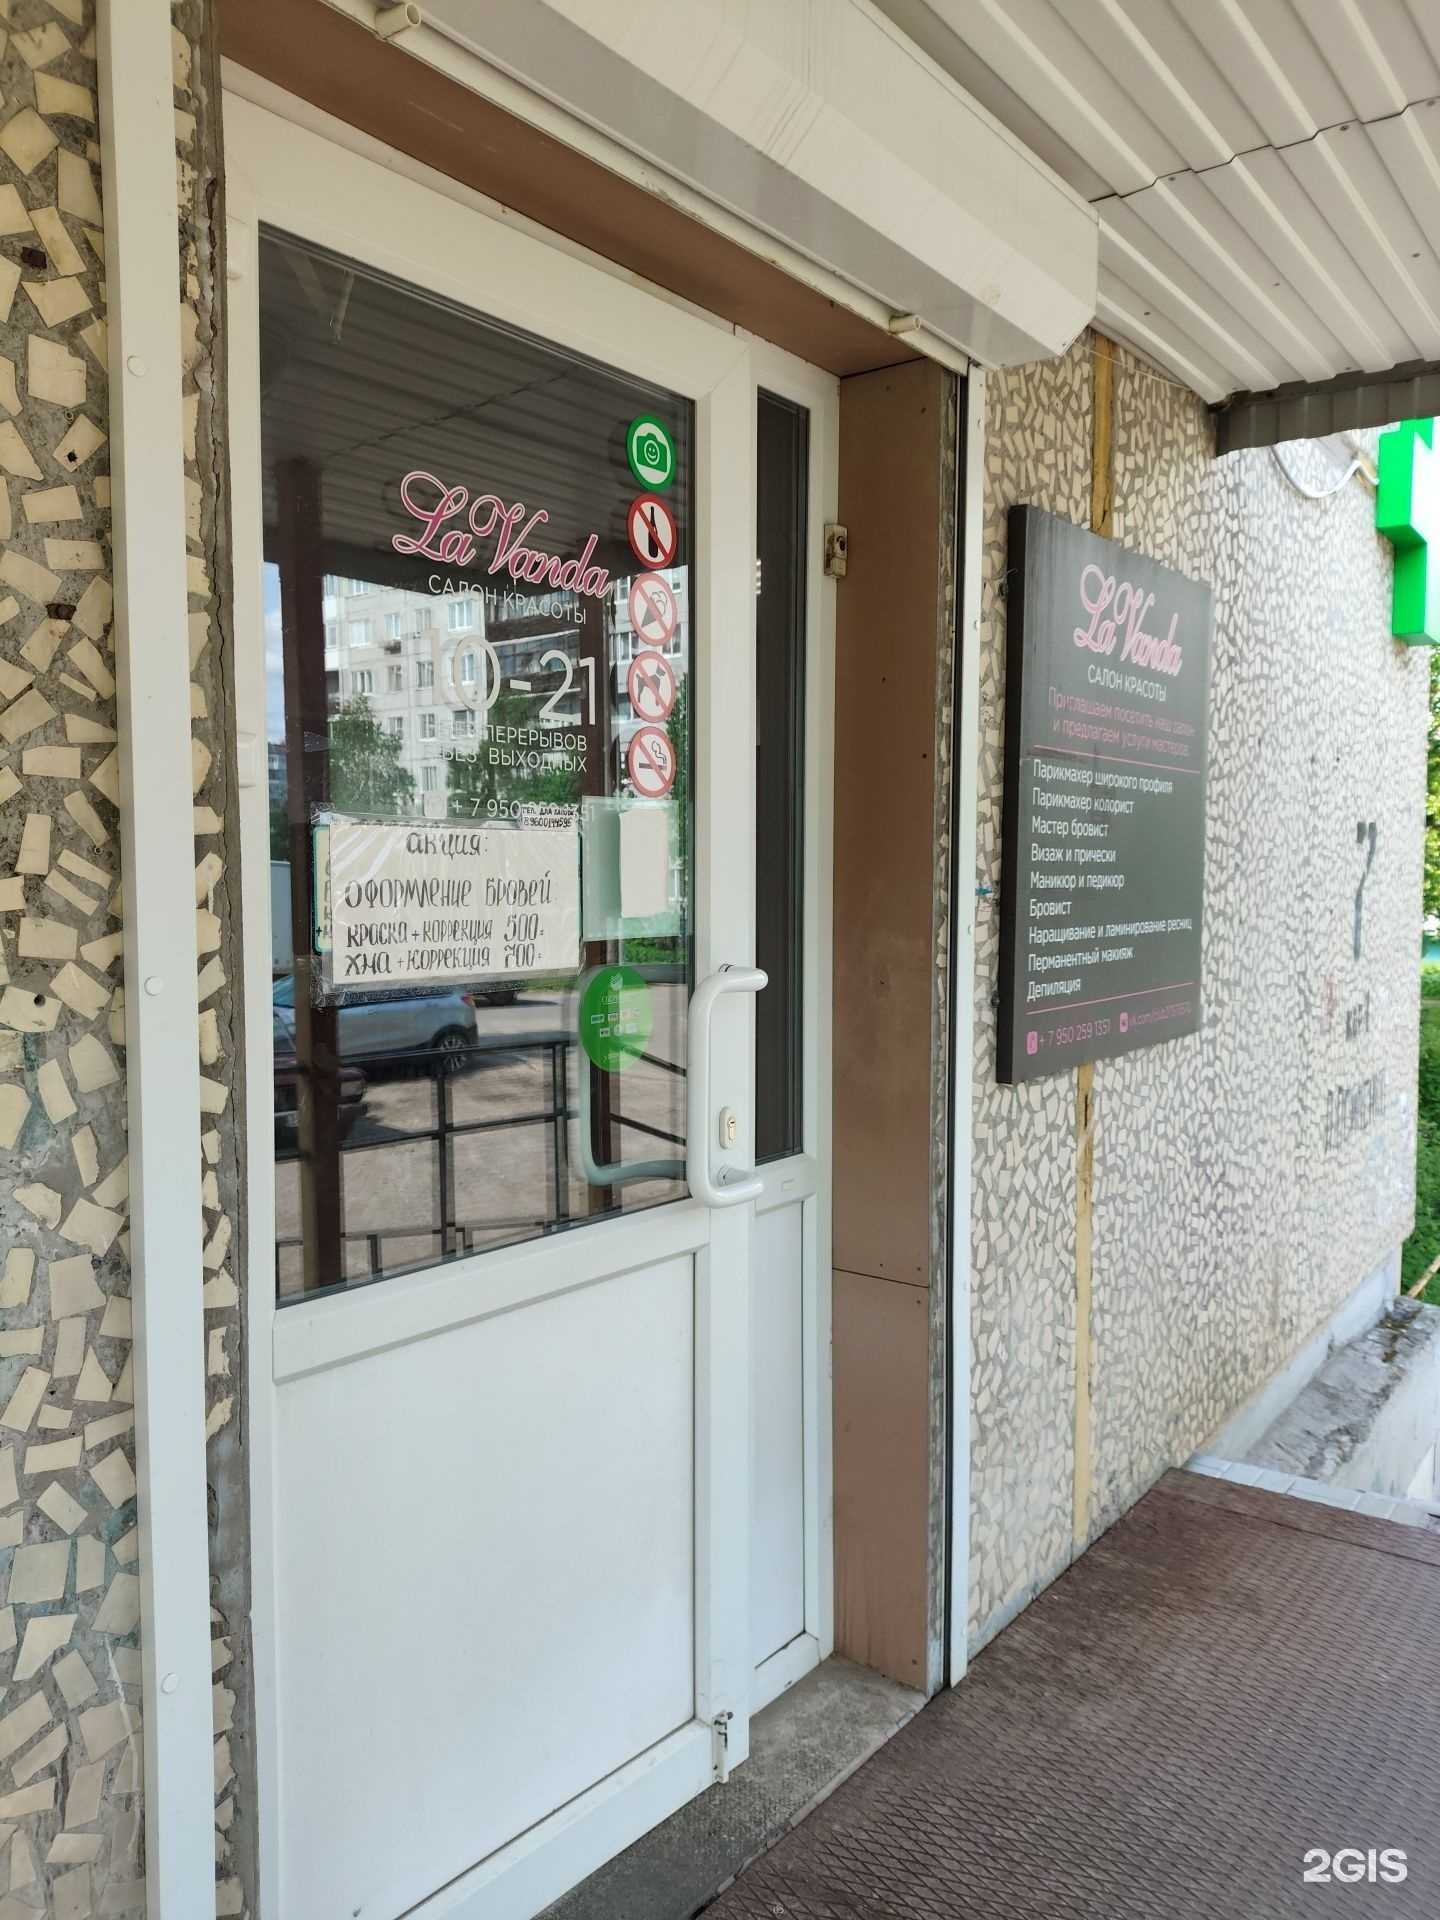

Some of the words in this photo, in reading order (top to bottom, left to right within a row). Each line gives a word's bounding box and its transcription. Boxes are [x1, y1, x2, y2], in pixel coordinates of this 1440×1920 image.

[392, 470, 477, 565] La
[468, 494, 613, 599] Vanda
[429, 575, 497, 606] САЛОН
[503, 586, 587, 625] КРАСОТЫ
[1074, 564, 1117, 656] La
[1113, 582, 1183, 676] Vanda
[1087, 664, 1123, 690] САЛОН
[1124, 674, 1167, 702] КРАСОТЫ
[1048, 686, 1113, 719] Приглашаем
[1061, 719, 1121, 744] предлагаем
[489, 748, 588, 773] ВЫХОДНЫХ
[1033, 759, 1093, 787] Парикмахер
[1095, 772, 1138, 790] широкого
[1032, 787, 1092, 813] Парикмахер
[1094, 797, 1135, 815] колорист
[1031, 815, 1069, 838] Мастер
[1071, 819, 1110, 838] бровист
[1031, 843, 1063, 862] Визаж
[1065, 848, 1073, 861] и
[1074, 849, 1117, 865] прически
[1030, 871, 1077, 891] Маникюр
[1078, 876, 1085, 887] и
[1086, 874, 1125, 890] педикюр
[1029, 898, 1073, 920] Бровист
[1028, 925, 1096, 947] Наращивание
[1097, 926, 1104, 938] и
[1105, 918, 1166, 938] ламинирование
[1028, 947, 1100, 974] Перманентный
[1100, 946, 1134, 963] макияж
[1026, 978, 1081, 1003] Депиляция
